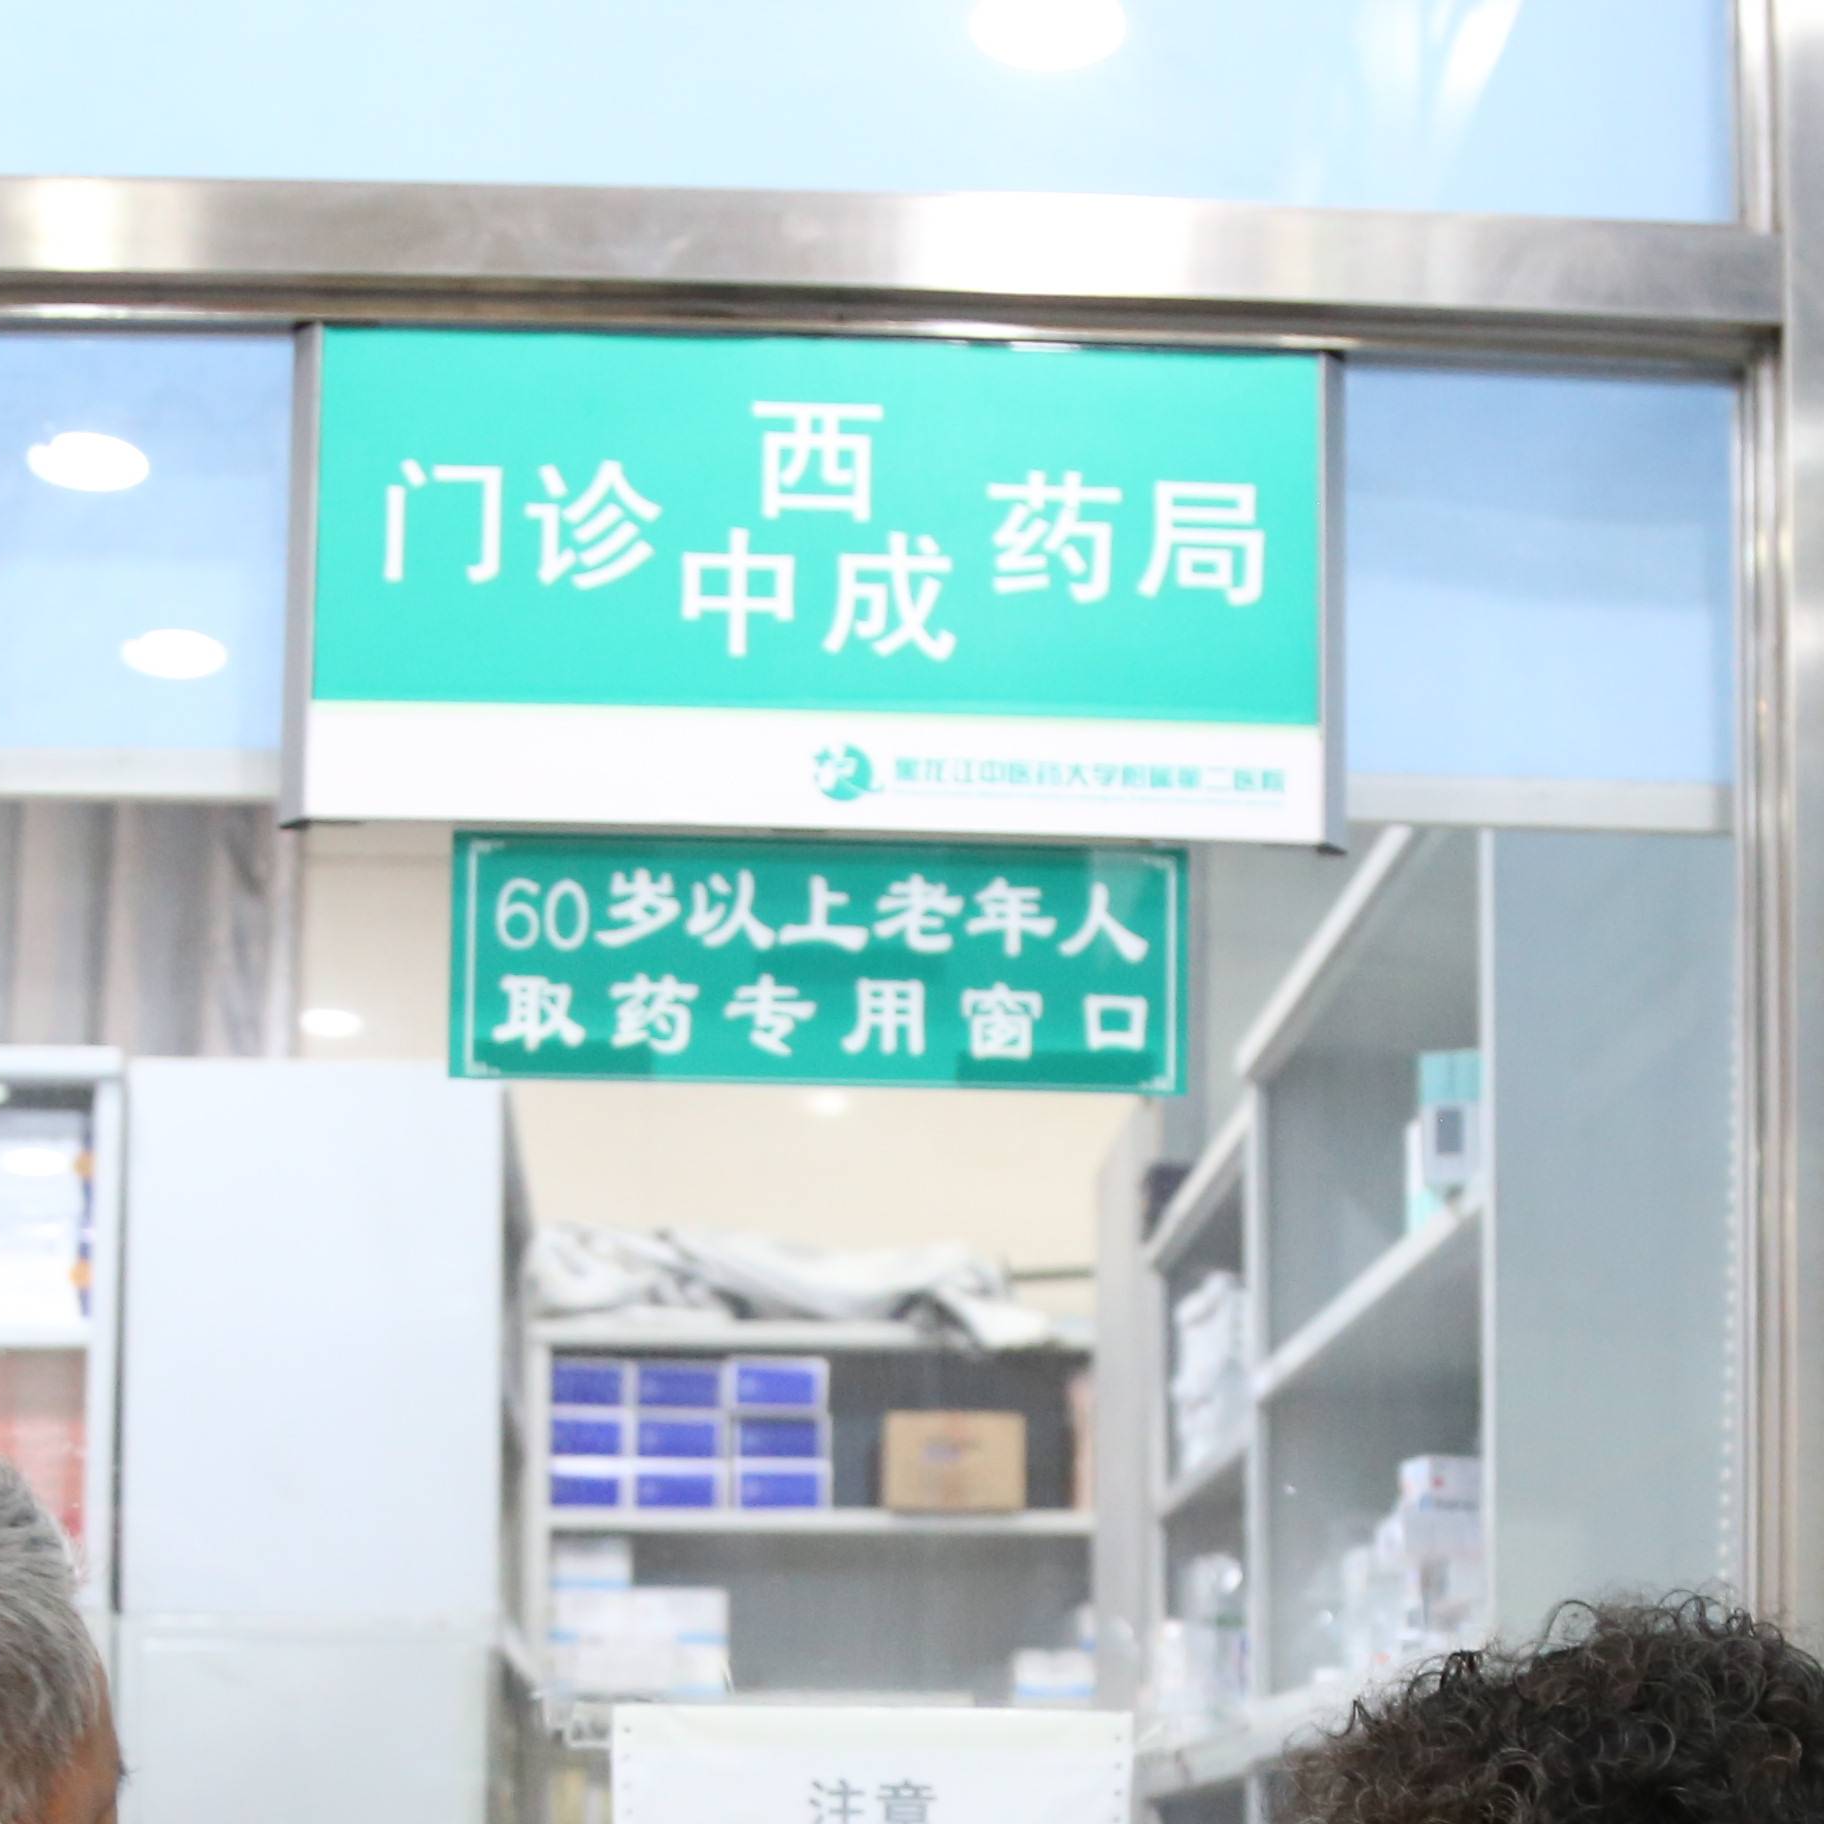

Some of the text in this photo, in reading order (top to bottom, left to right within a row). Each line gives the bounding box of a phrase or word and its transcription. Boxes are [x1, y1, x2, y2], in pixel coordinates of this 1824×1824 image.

[383, 458, 663, 590] 门诊
[752, 400, 884, 522] 西
[681, 526, 957, 662] 中成
[987, 470, 1265, 607] 药局
[495, 868, 1148, 962] 60岁以上老年人
[492, 974, 1148, 1059] 取药专用窗口
